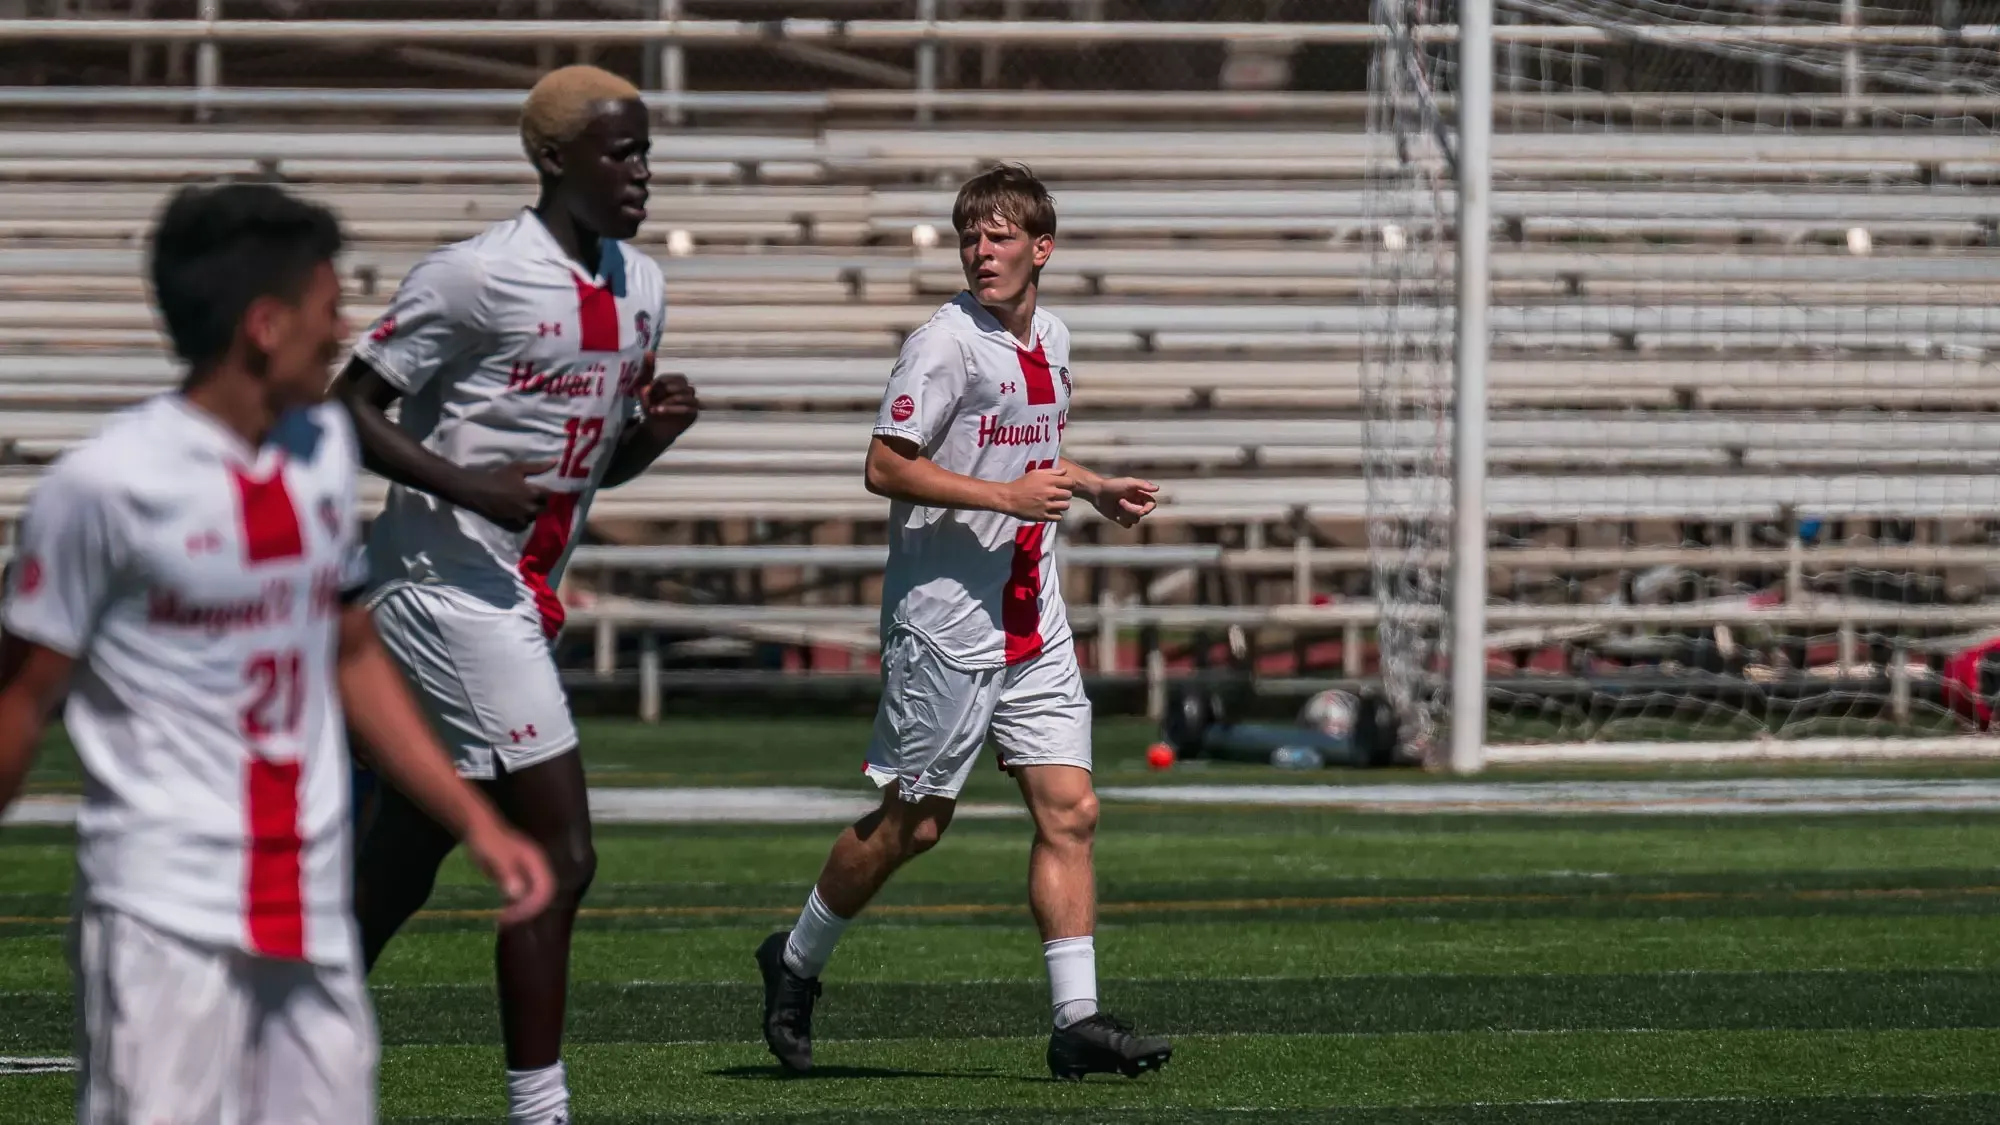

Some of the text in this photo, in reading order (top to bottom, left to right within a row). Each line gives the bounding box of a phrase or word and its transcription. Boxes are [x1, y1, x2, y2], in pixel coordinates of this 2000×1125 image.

[559, 417, 604, 478] 12
[977, 413, 1051, 448] Hawai'i
[243, 653, 302, 736] 21
